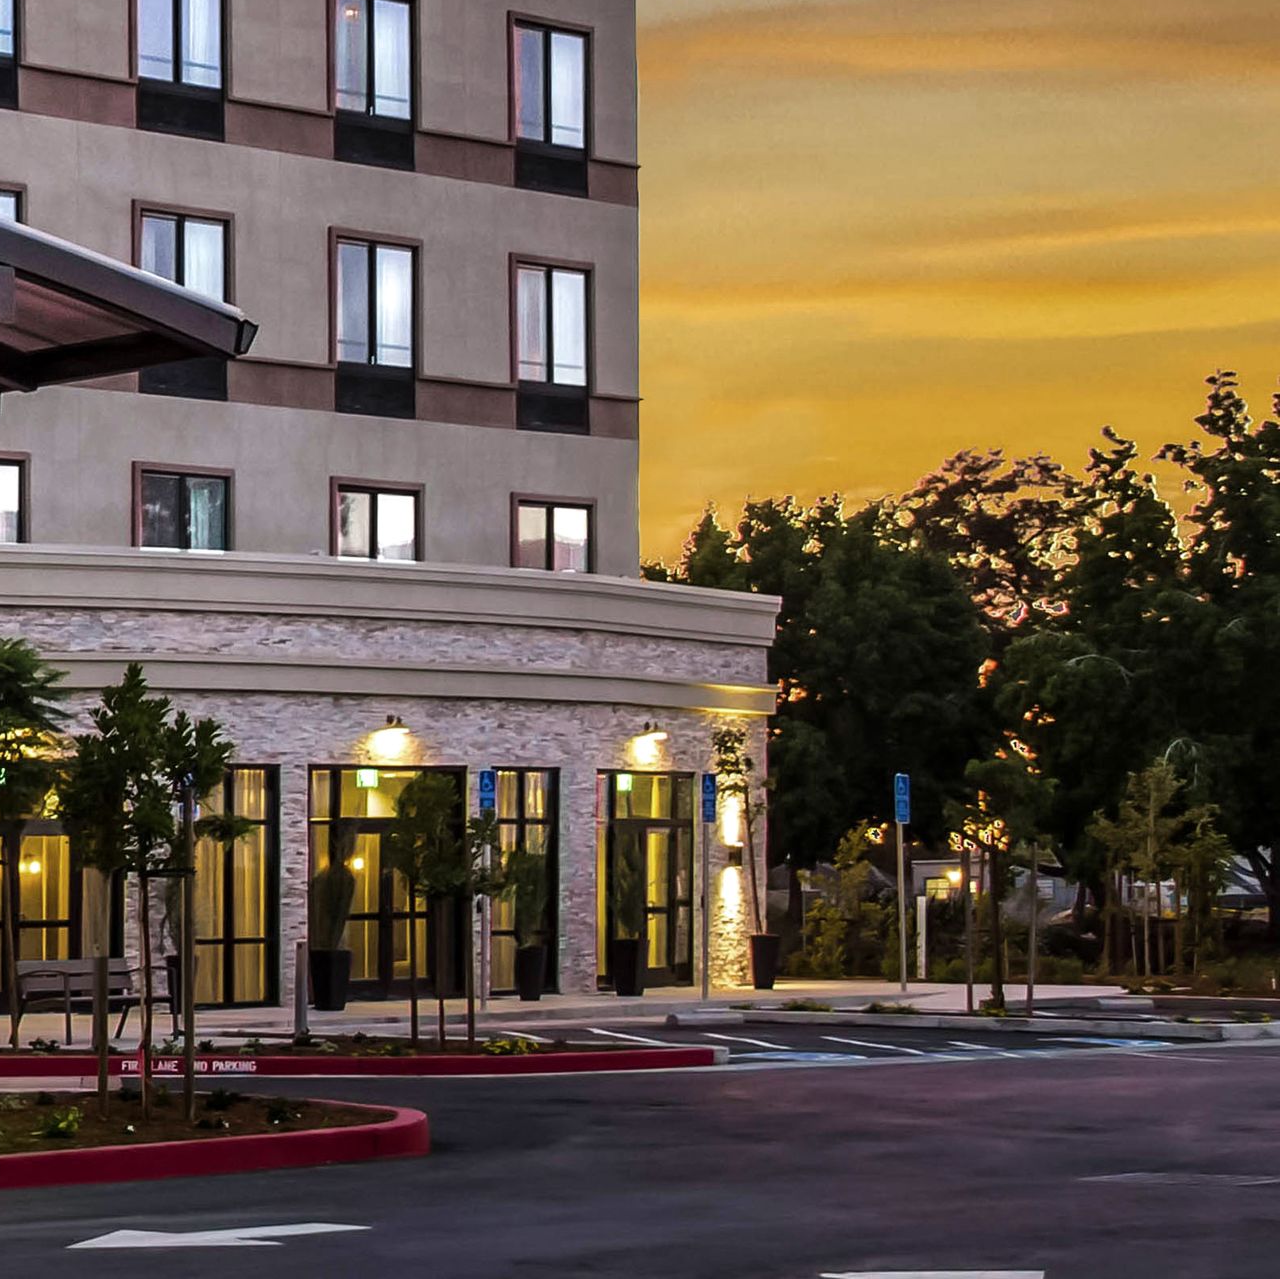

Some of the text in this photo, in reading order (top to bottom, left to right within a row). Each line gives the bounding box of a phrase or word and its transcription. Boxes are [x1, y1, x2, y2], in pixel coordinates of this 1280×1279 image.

[121, 1060, 139, 1071] FIR
[151, 1060, 178, 1072] LANE
[212, 1060, 257, 1072] PARKING
